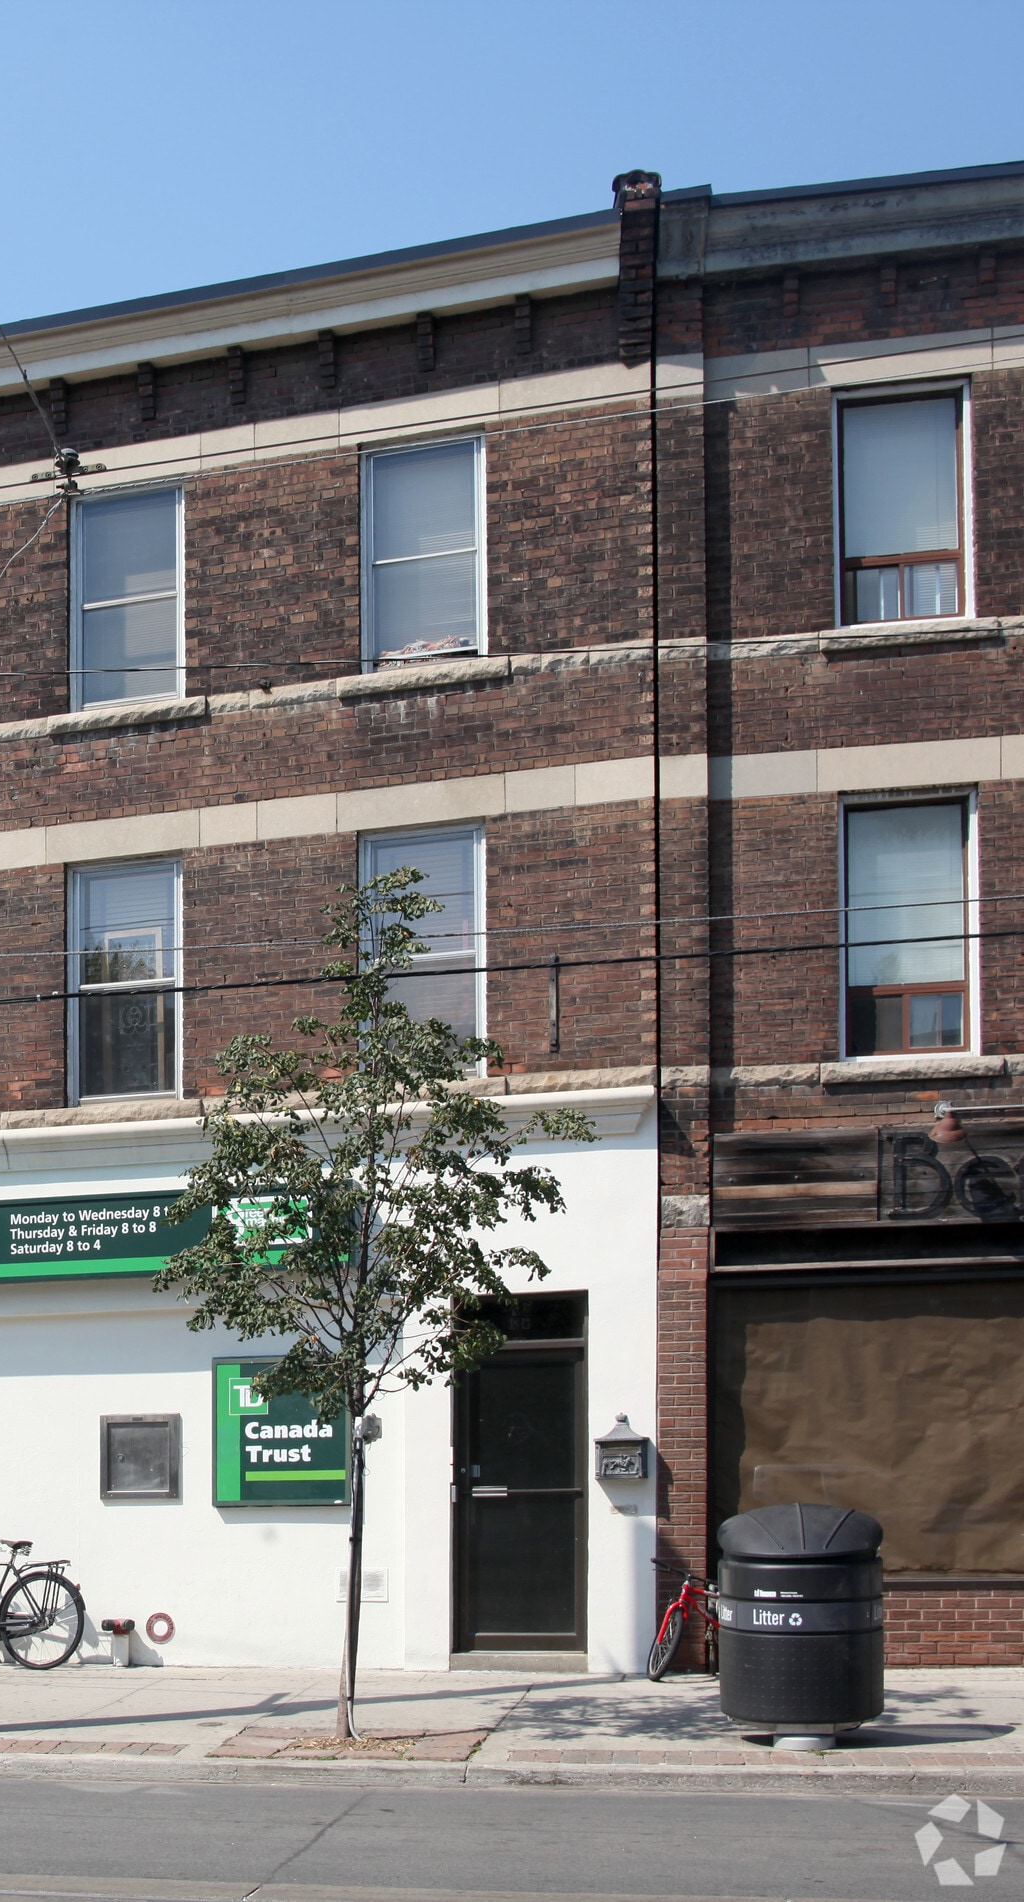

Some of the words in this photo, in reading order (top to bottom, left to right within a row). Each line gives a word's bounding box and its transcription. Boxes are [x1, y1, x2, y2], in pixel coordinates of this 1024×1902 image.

[886, 1131, 1024, 1221] Be
[10, 1212, 59, 1225] Monday
[62, 1211, 76, 1222] to
[78, 1207, 150, 1221] Wednesday
[153, 1205, 161, 1217] 8
[10, 1227, 65, 1240] Thursday
[68, 1225, 78, 1237] &
[81, 1222, 119, 1237] Friday
[121, 1223, 129, 1234] 8
[132, 1221, 146, 1233] to
[148, 1221, 157, 1233] 8
[10, 1241, 63, 1255] Saturday
[66, 1240, 74, 1252] 8
[77, 1240, 90, 1251] to
[93, 1239, 102, 1250] 4
[233, 1385, 267, 1407] TD
[244, 1419, 333, 1439] Canada
[245, 1444, 312, 1463] Trust
[753, 1608, 785, 1626] Litter
